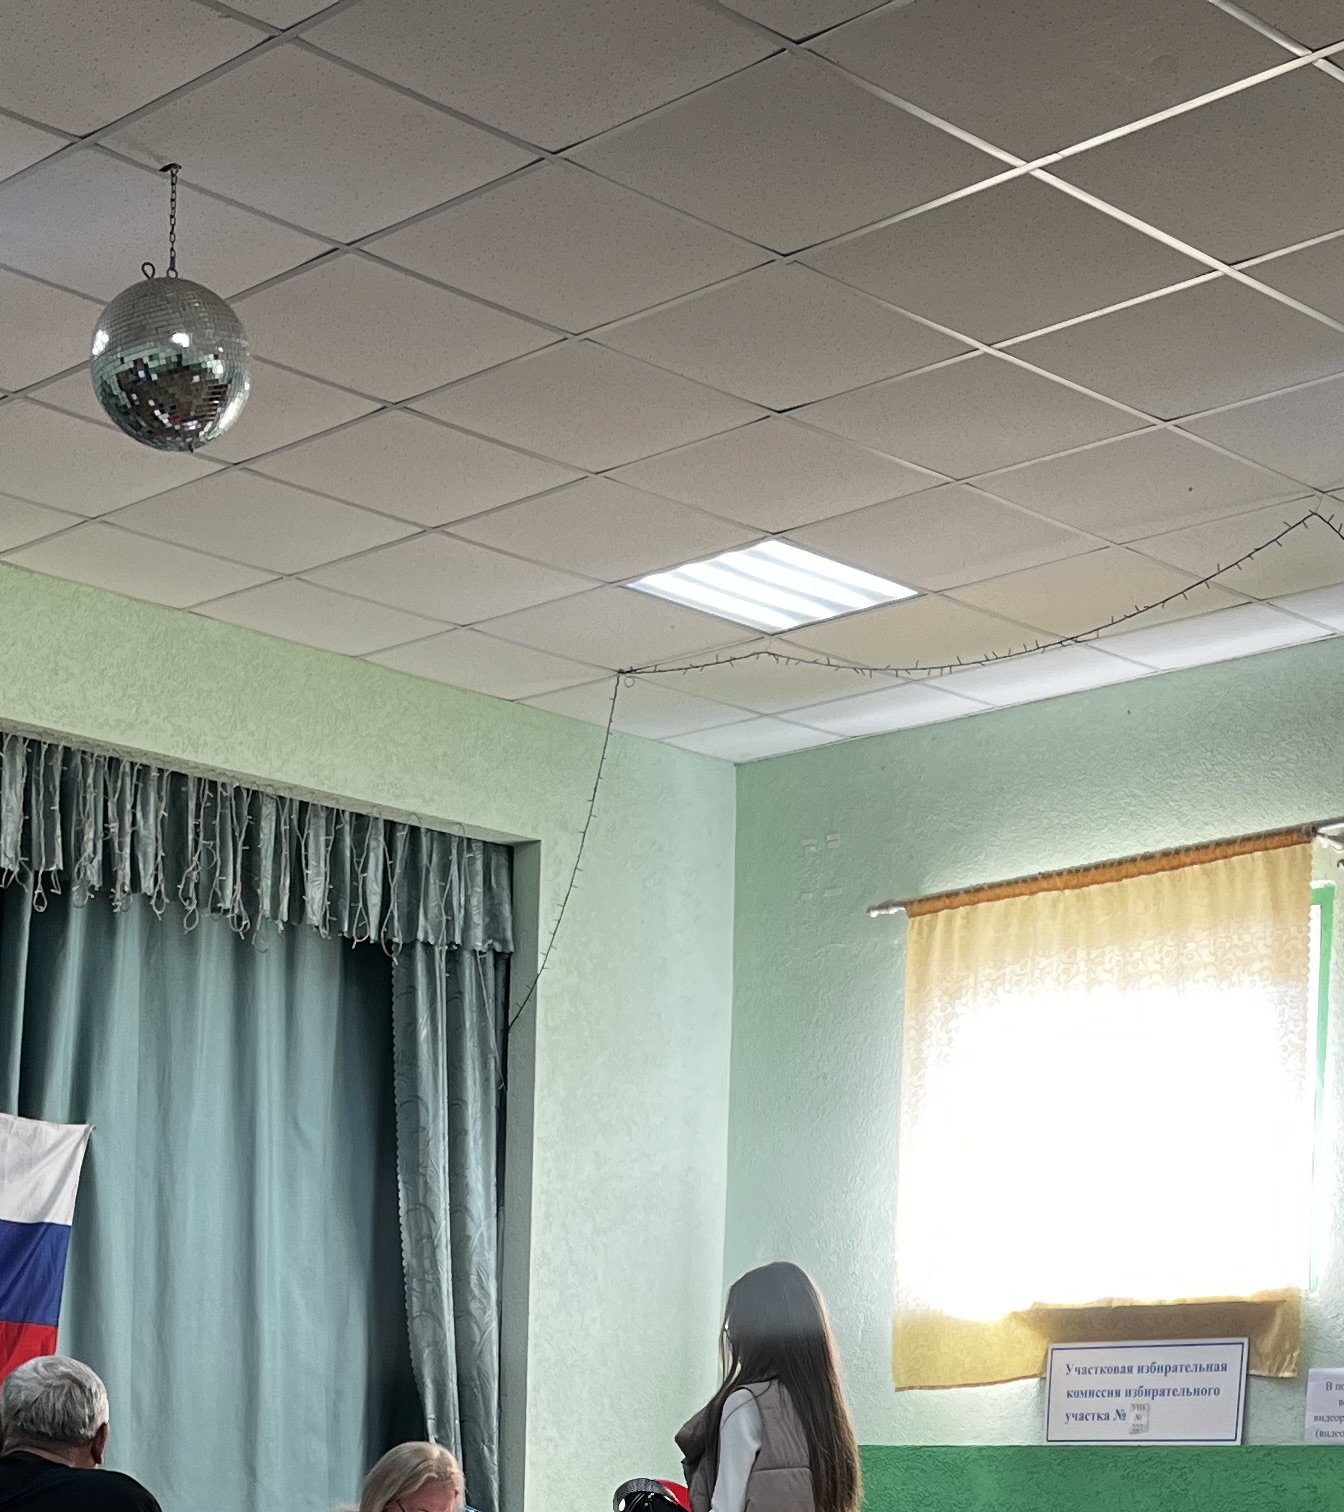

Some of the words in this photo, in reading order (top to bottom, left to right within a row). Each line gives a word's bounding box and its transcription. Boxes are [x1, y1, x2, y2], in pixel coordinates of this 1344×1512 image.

[1065, 1363, 1134, 1376] Участковая
[1136, 1361, 1228, 1378] избирательная
[1066, 1388, 1121, 1399] комиссия
[1124, 1385, 1221, 1400] избирательного
[1325, 1381, 1333, 1391] В
[1064, 1411, 1110, 1425] участка
[1112, 1409, 1127, 1421] №
